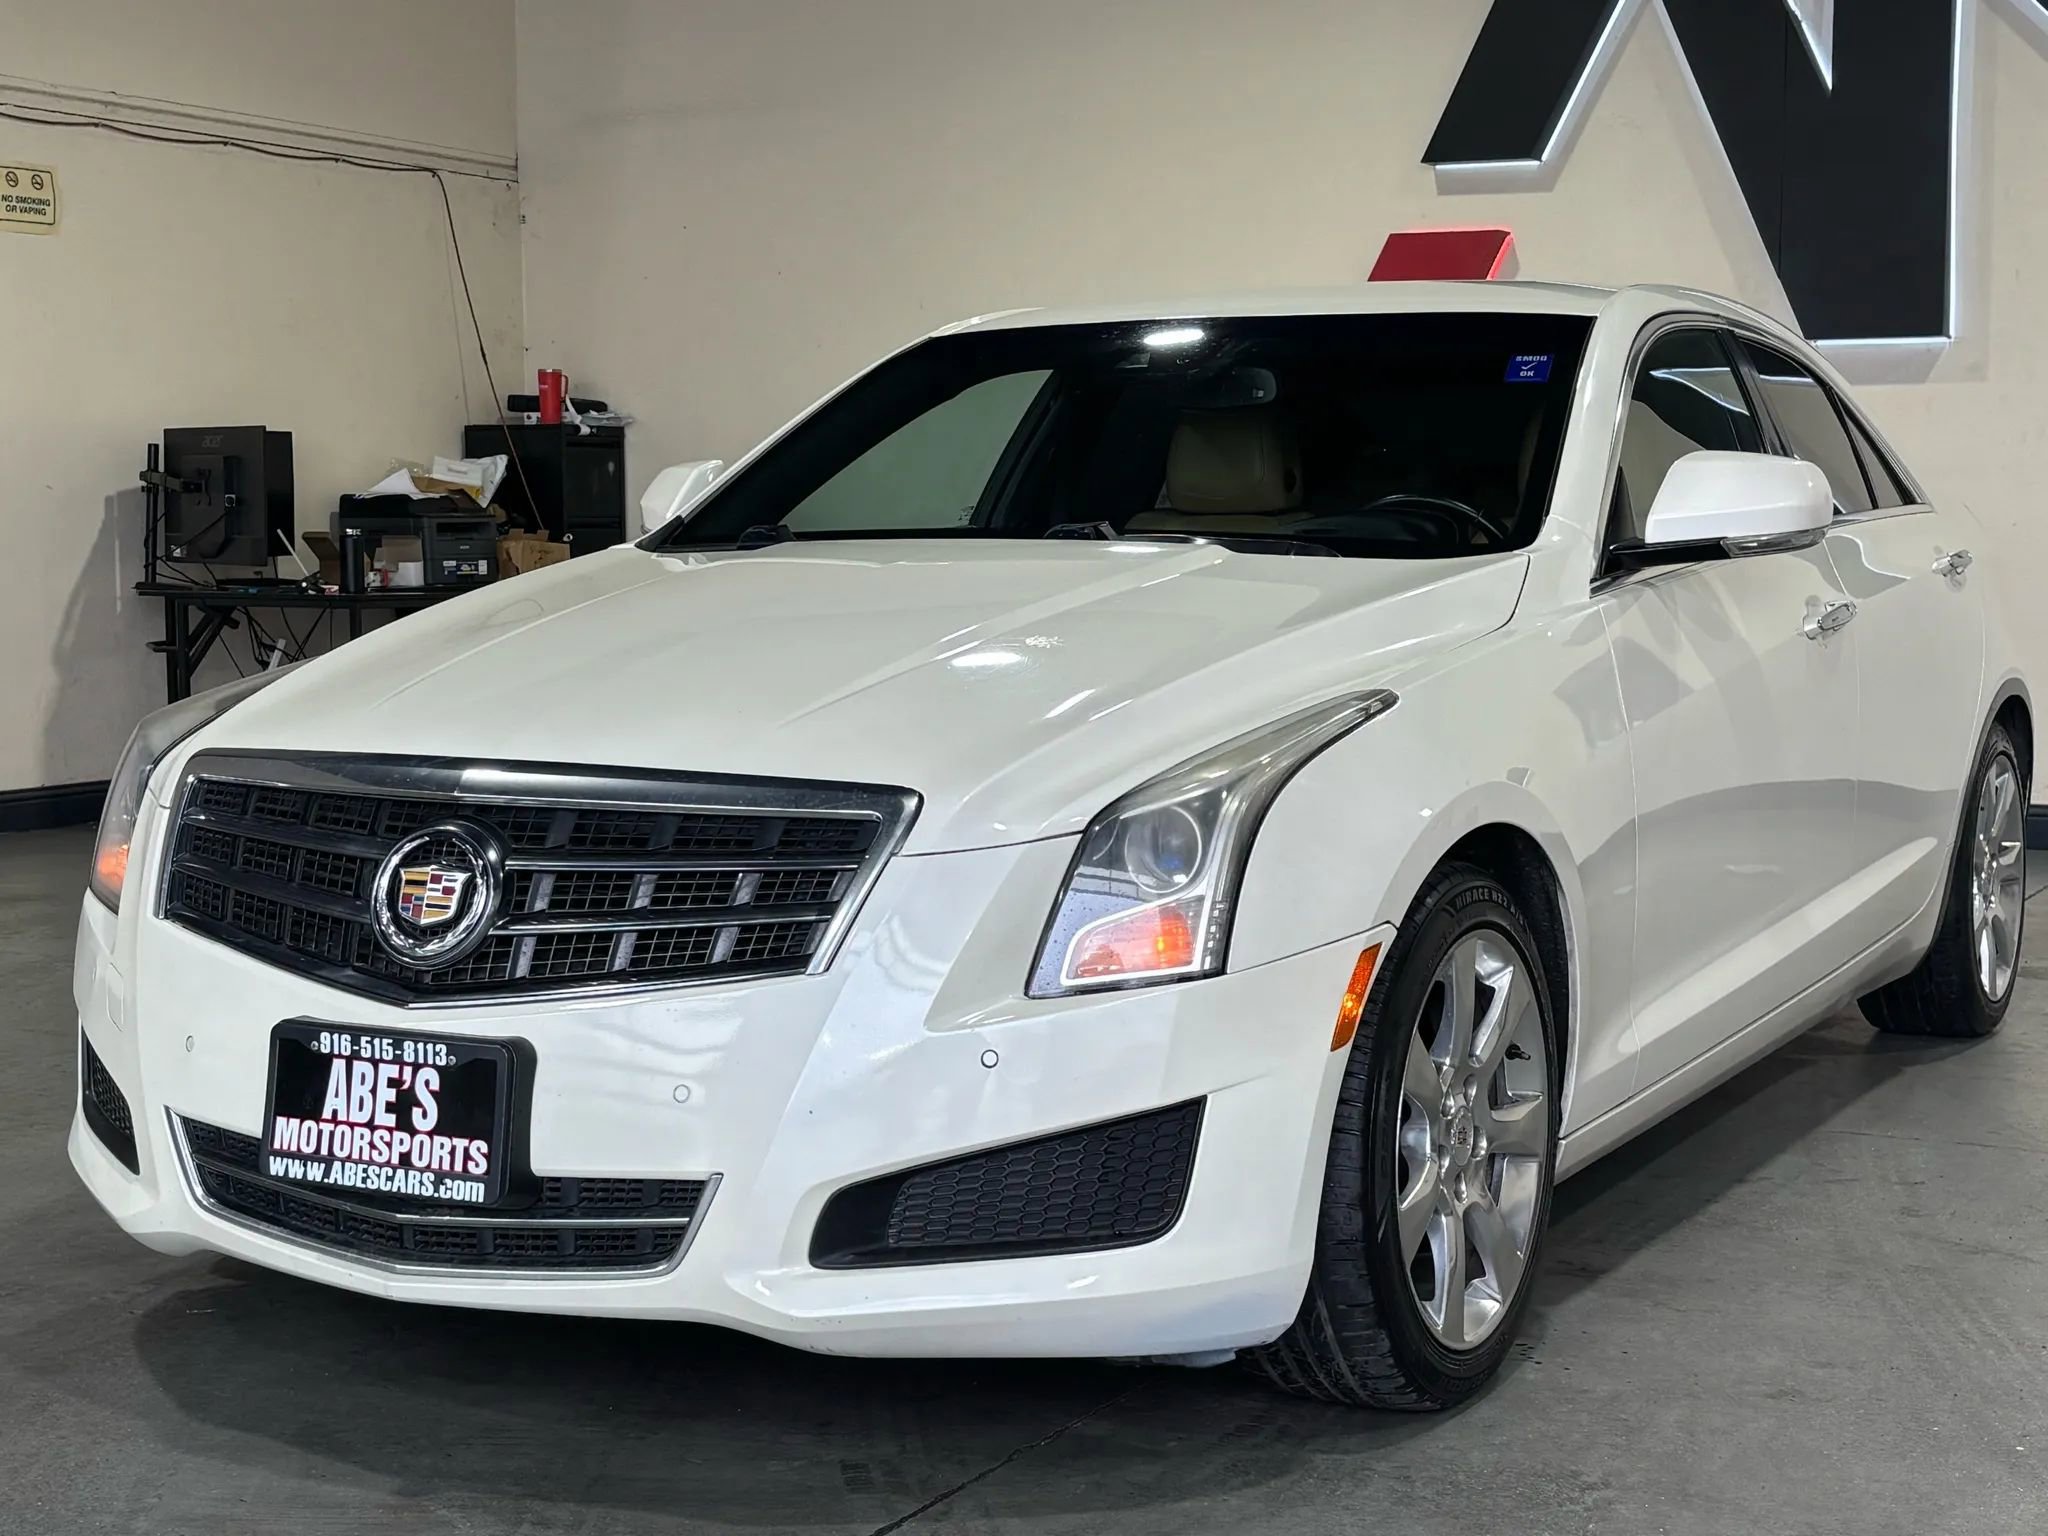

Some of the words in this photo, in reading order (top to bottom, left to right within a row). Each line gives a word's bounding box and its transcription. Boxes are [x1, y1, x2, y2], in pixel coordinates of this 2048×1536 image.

[1, 194, 14, 203] NO
[15, 195, 51, 207] SMOKING
[5, 204, 18, 214] OR
[18, 205, 47, 216] VAPING
[319, 1032, 448, 1066] 916-515-8113
[321, 1058, 441, 1132] ABE'S
[273, 1116, 488, 1175] MOTORSPORTS
